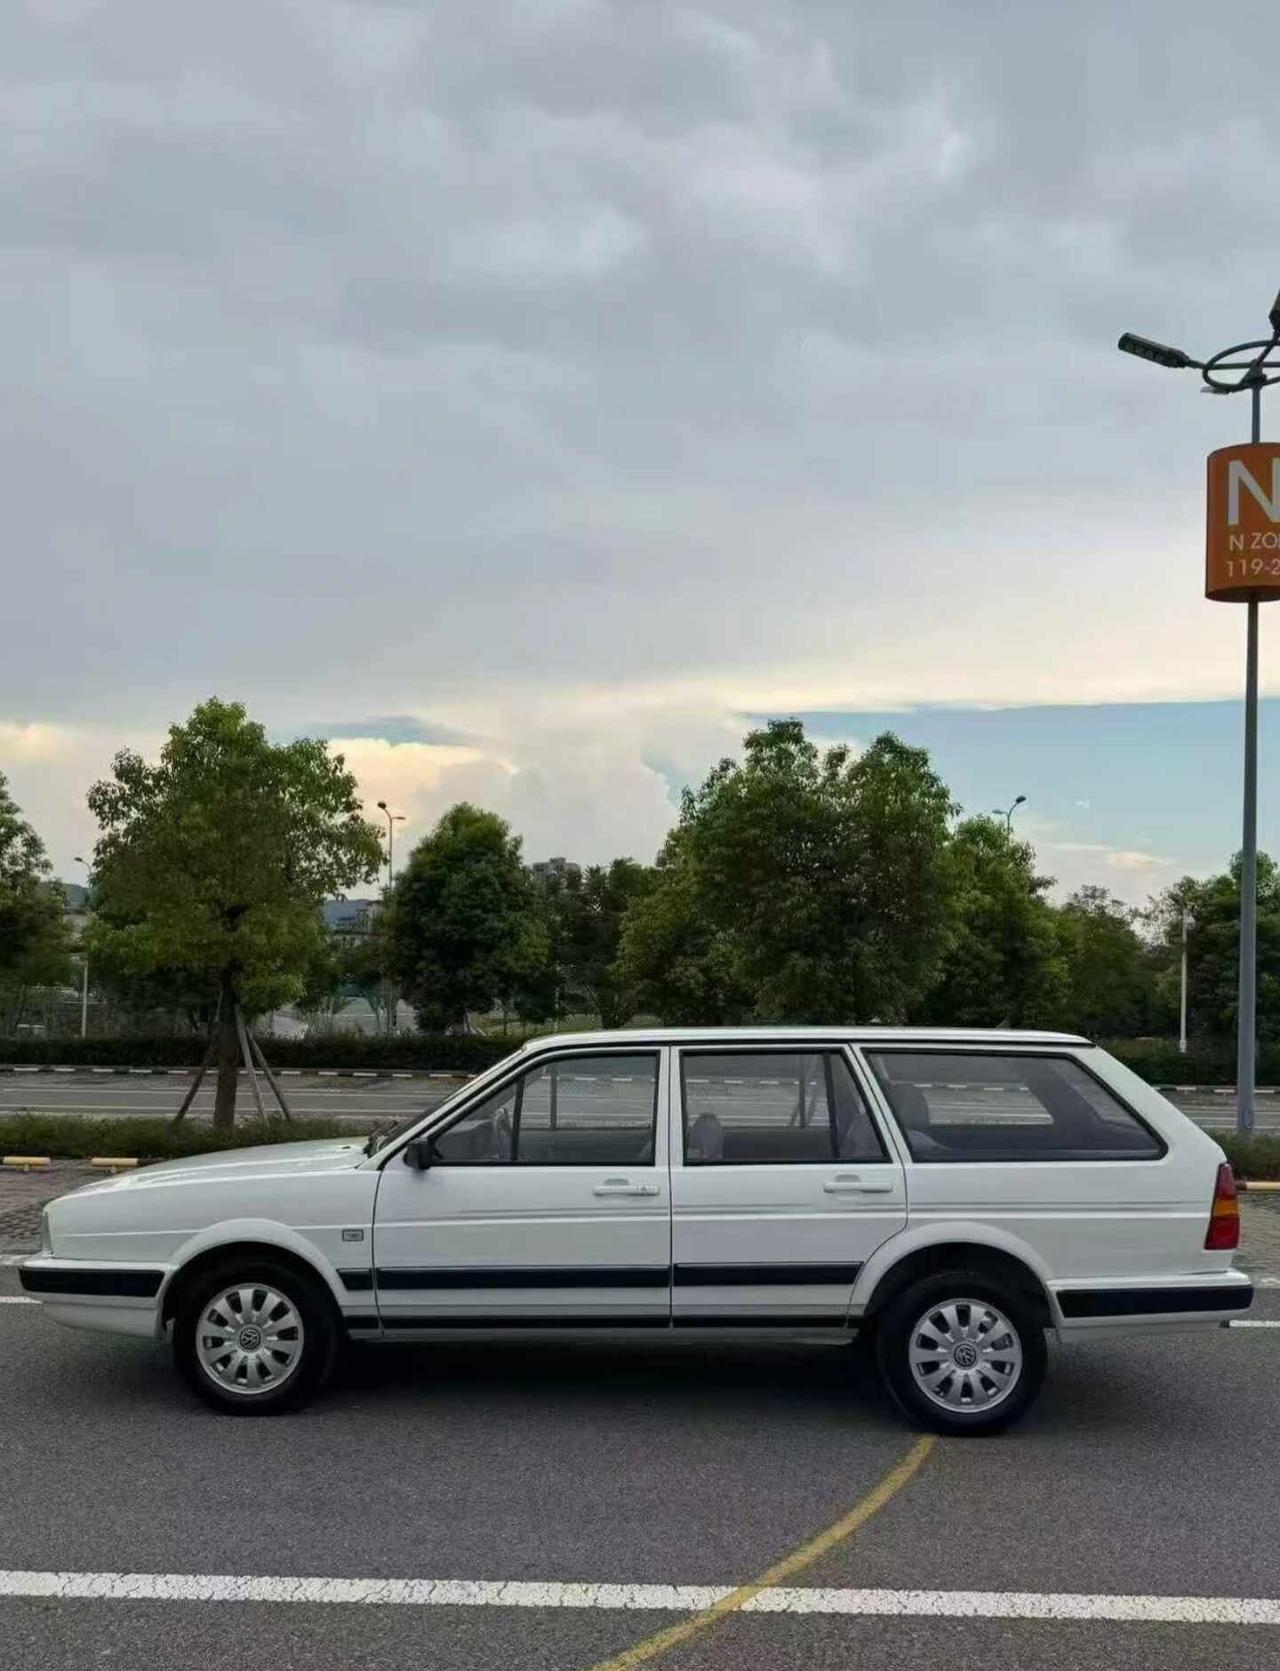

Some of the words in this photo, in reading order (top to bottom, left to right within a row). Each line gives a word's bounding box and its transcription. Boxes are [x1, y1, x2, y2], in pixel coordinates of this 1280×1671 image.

[1228, 458, 1280, 525] N
[1229, 534, 1244, 551] N
[1250, 532, 1280, 549] ZO
[1226, 558, 1280, 578] 119-2
